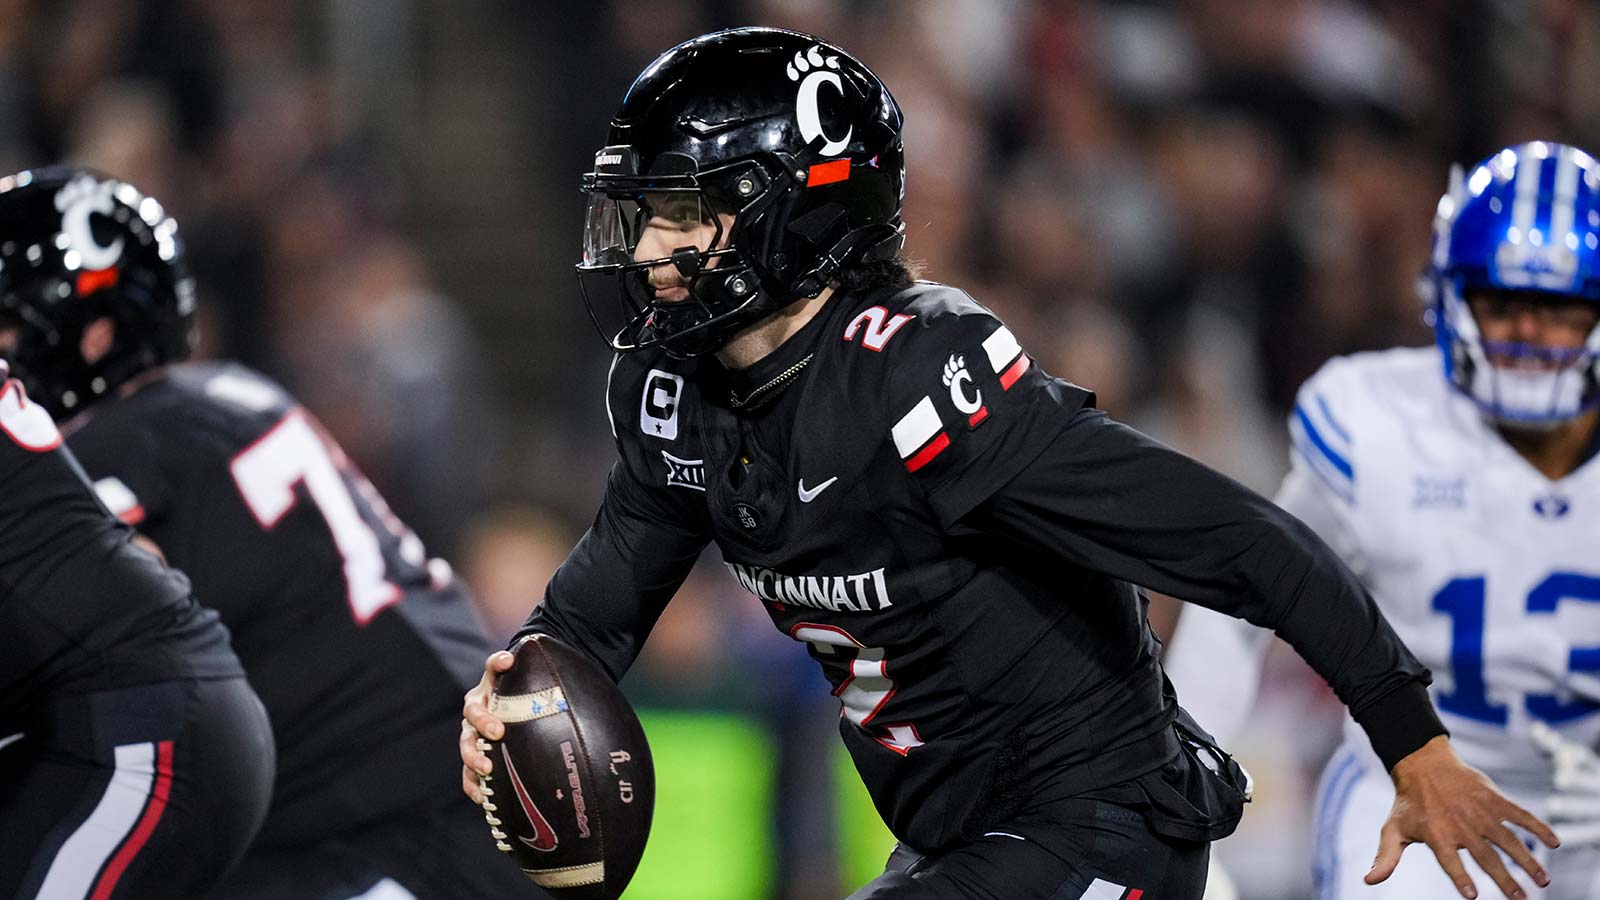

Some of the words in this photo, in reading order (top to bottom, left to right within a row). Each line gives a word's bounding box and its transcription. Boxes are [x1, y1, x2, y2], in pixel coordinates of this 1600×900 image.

[843, 305, 917, 353] 2
[645, 375, 678, 422] C
[738, 507, 750, 518] JK
[741, 517, 756, 529] 58
[723, 561, 893, 612] INCINNATI
[1432, 571, 1600, 725] 13
[790, 621, 926, 757] 2
